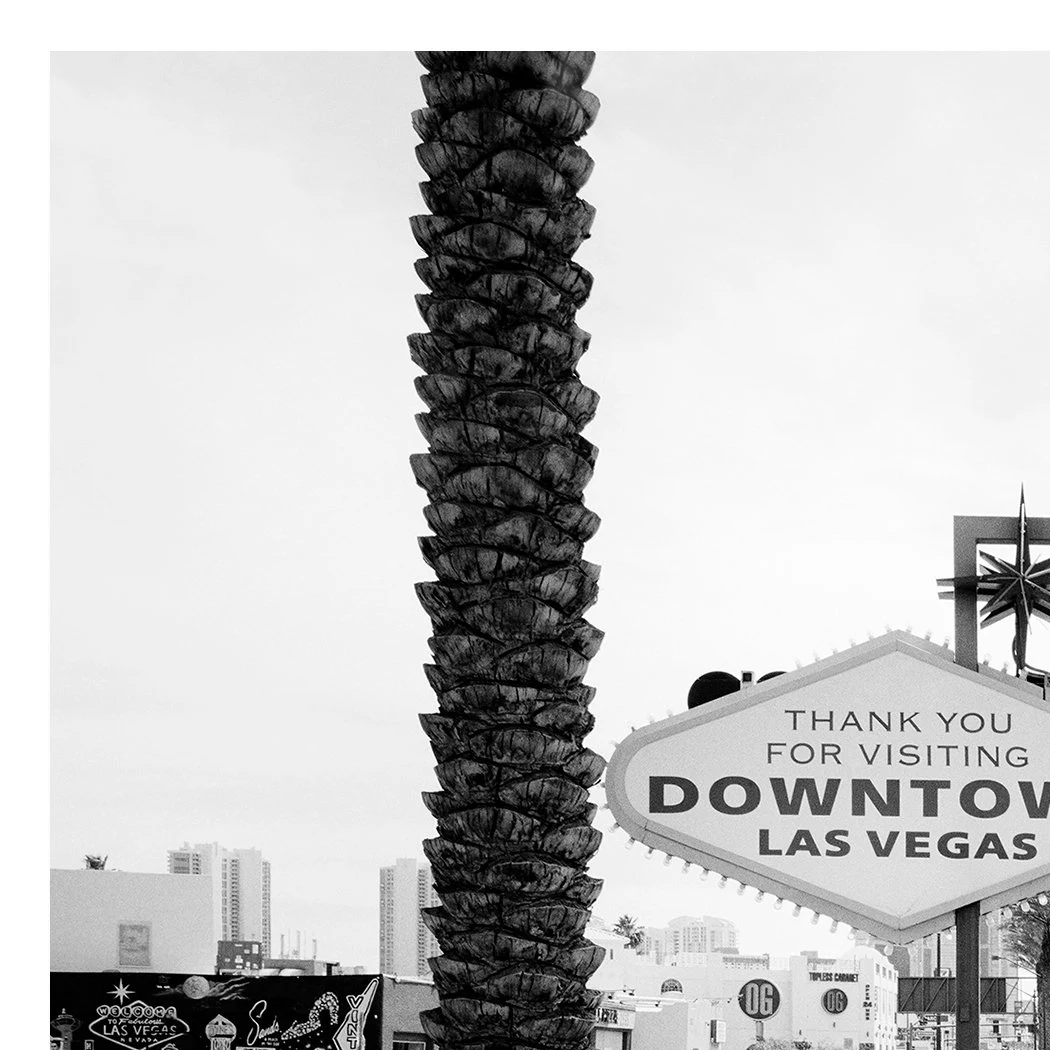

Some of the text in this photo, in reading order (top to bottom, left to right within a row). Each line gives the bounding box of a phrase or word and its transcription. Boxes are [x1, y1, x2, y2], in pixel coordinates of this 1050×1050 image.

[785, 709, 1012, 734] THANK YOU
[767, 742, 1029, 768] FOR VISITING
[758, 829, 1038, 861] LAS VEGAS
[808, 971, 833, 982] TOPLESS
[745, 982, 774, 1016] OG
[826, 990, 844, 1012] OG
[98, 1006, 175, 1018] WELCOME
[103, 1025, 177, 1036] LAS VEGAS
